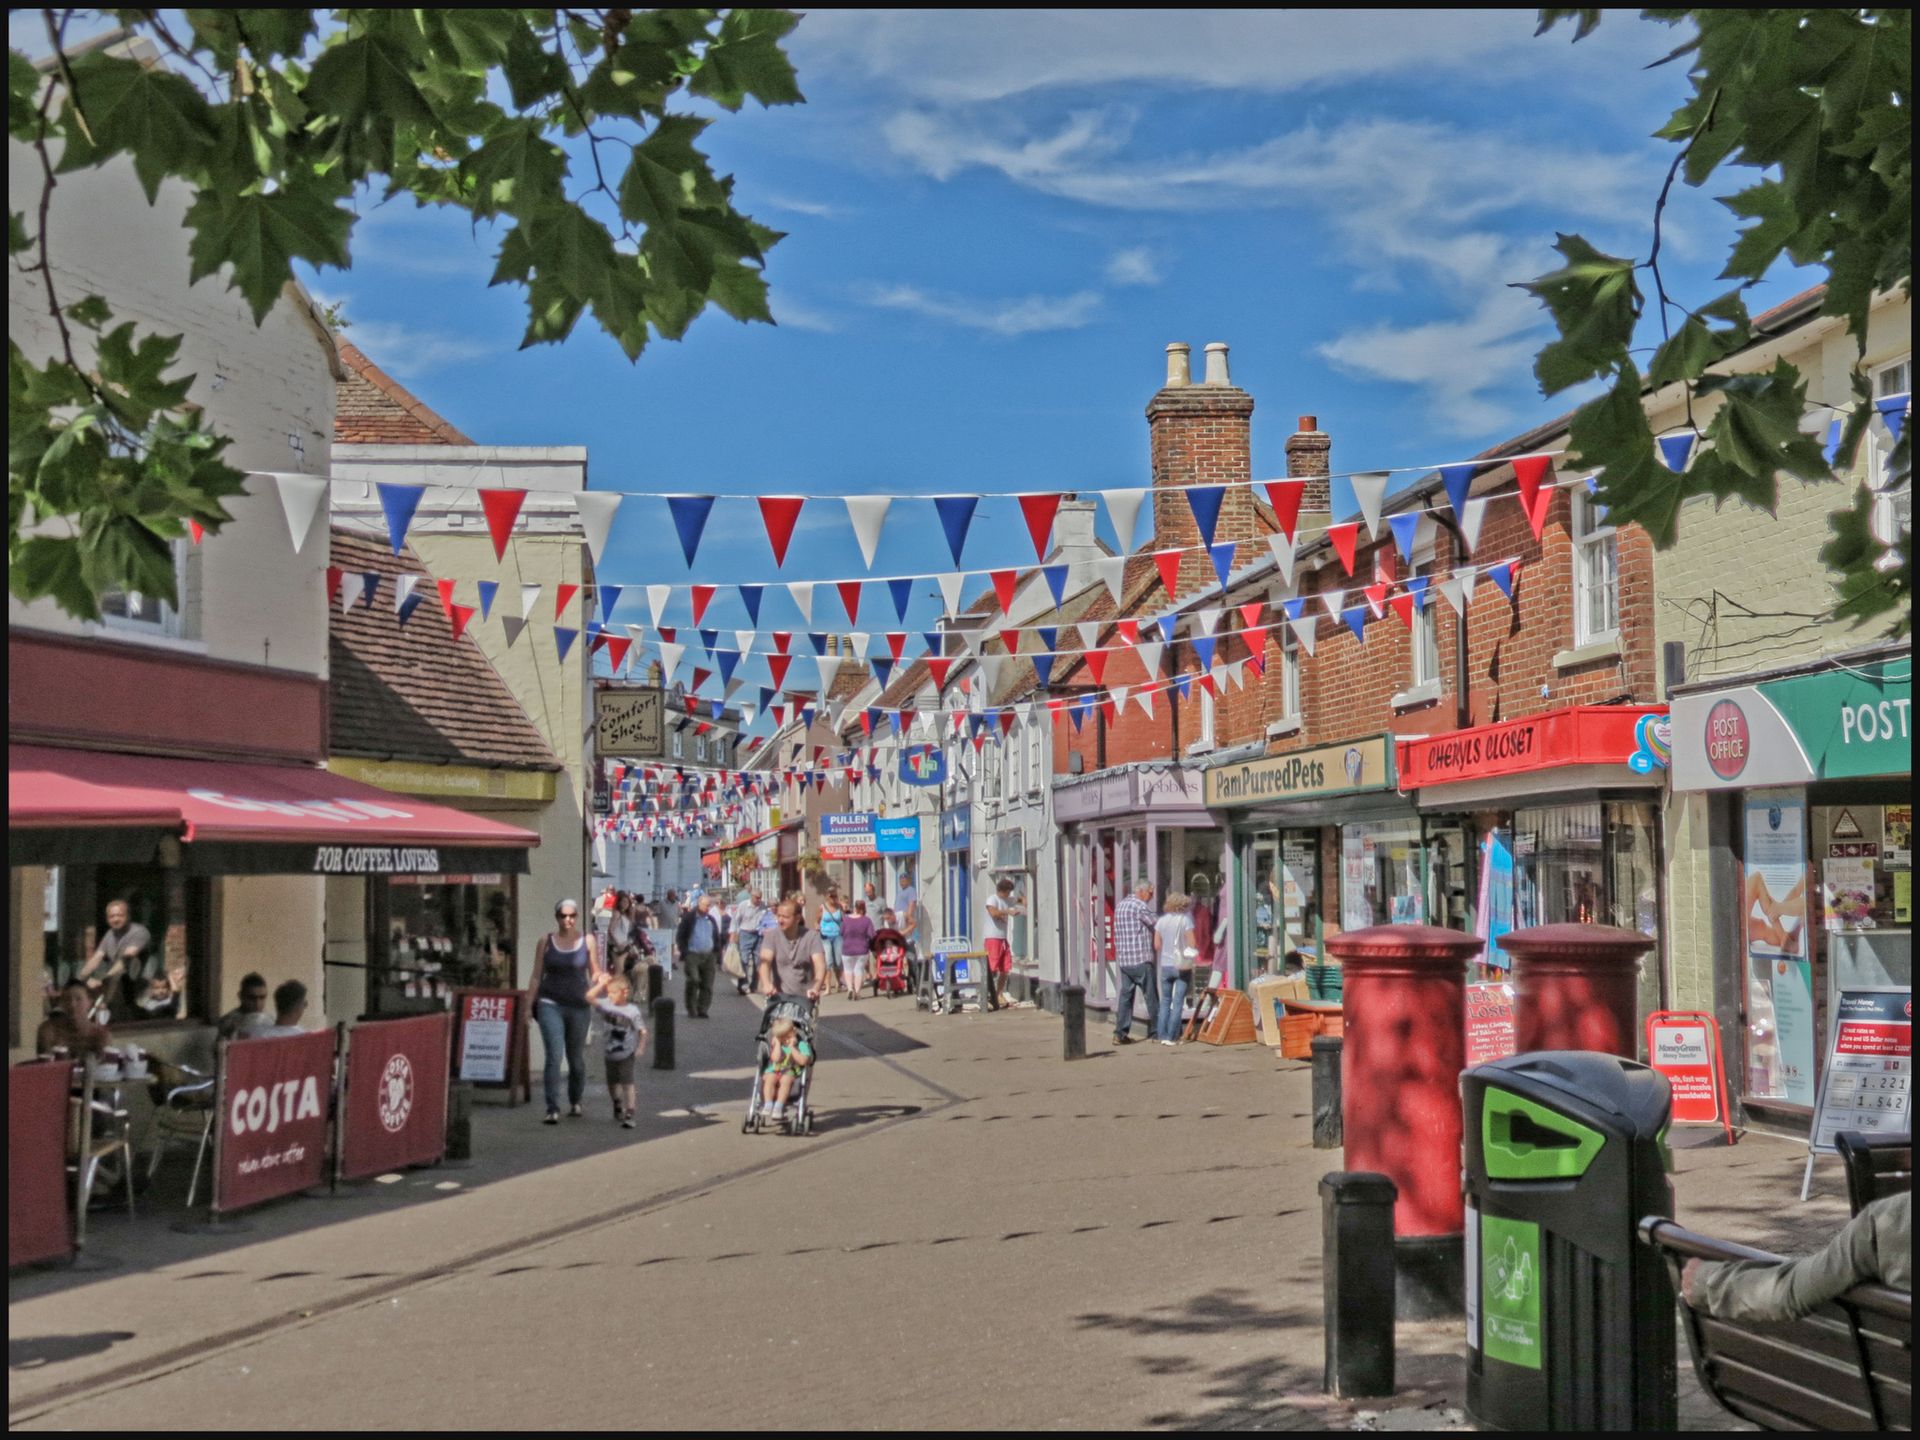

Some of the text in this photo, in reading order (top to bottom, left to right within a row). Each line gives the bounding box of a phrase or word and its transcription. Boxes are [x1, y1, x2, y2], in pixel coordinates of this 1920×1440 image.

[601, 695, 657, 733] Comfort
[602, 704, 621, 713] The
[610, 720, 643, 744] Shoe
[1713, 716, 1739, 736] POST
[1841, 698, 1911, 744] POST
[633, 732, 658, 745] Shop
[1428, 726, 1534, 772] CHERYLS CLOSET
[1710, 739, 1744, 760] OFFICE
[1216, 758, 1325, 799] PamPurredPets
[830, 815, 869, 825] PULLEN
[313, 846, 440, 872] FOR COFFEE LOVERS
[471, 997, 507, 1009] SALE
[1857, 999, 1875, 1007] Money
[470, 1009, 505, 1021] SALE
[1658, 1044, 1702, 1052] MoneyGram
[384, 1059, 409, 1082] COSTA
[230, 1076, 321, 1136] COSTA
[381, 1098, 411, 1126] COFFEE
